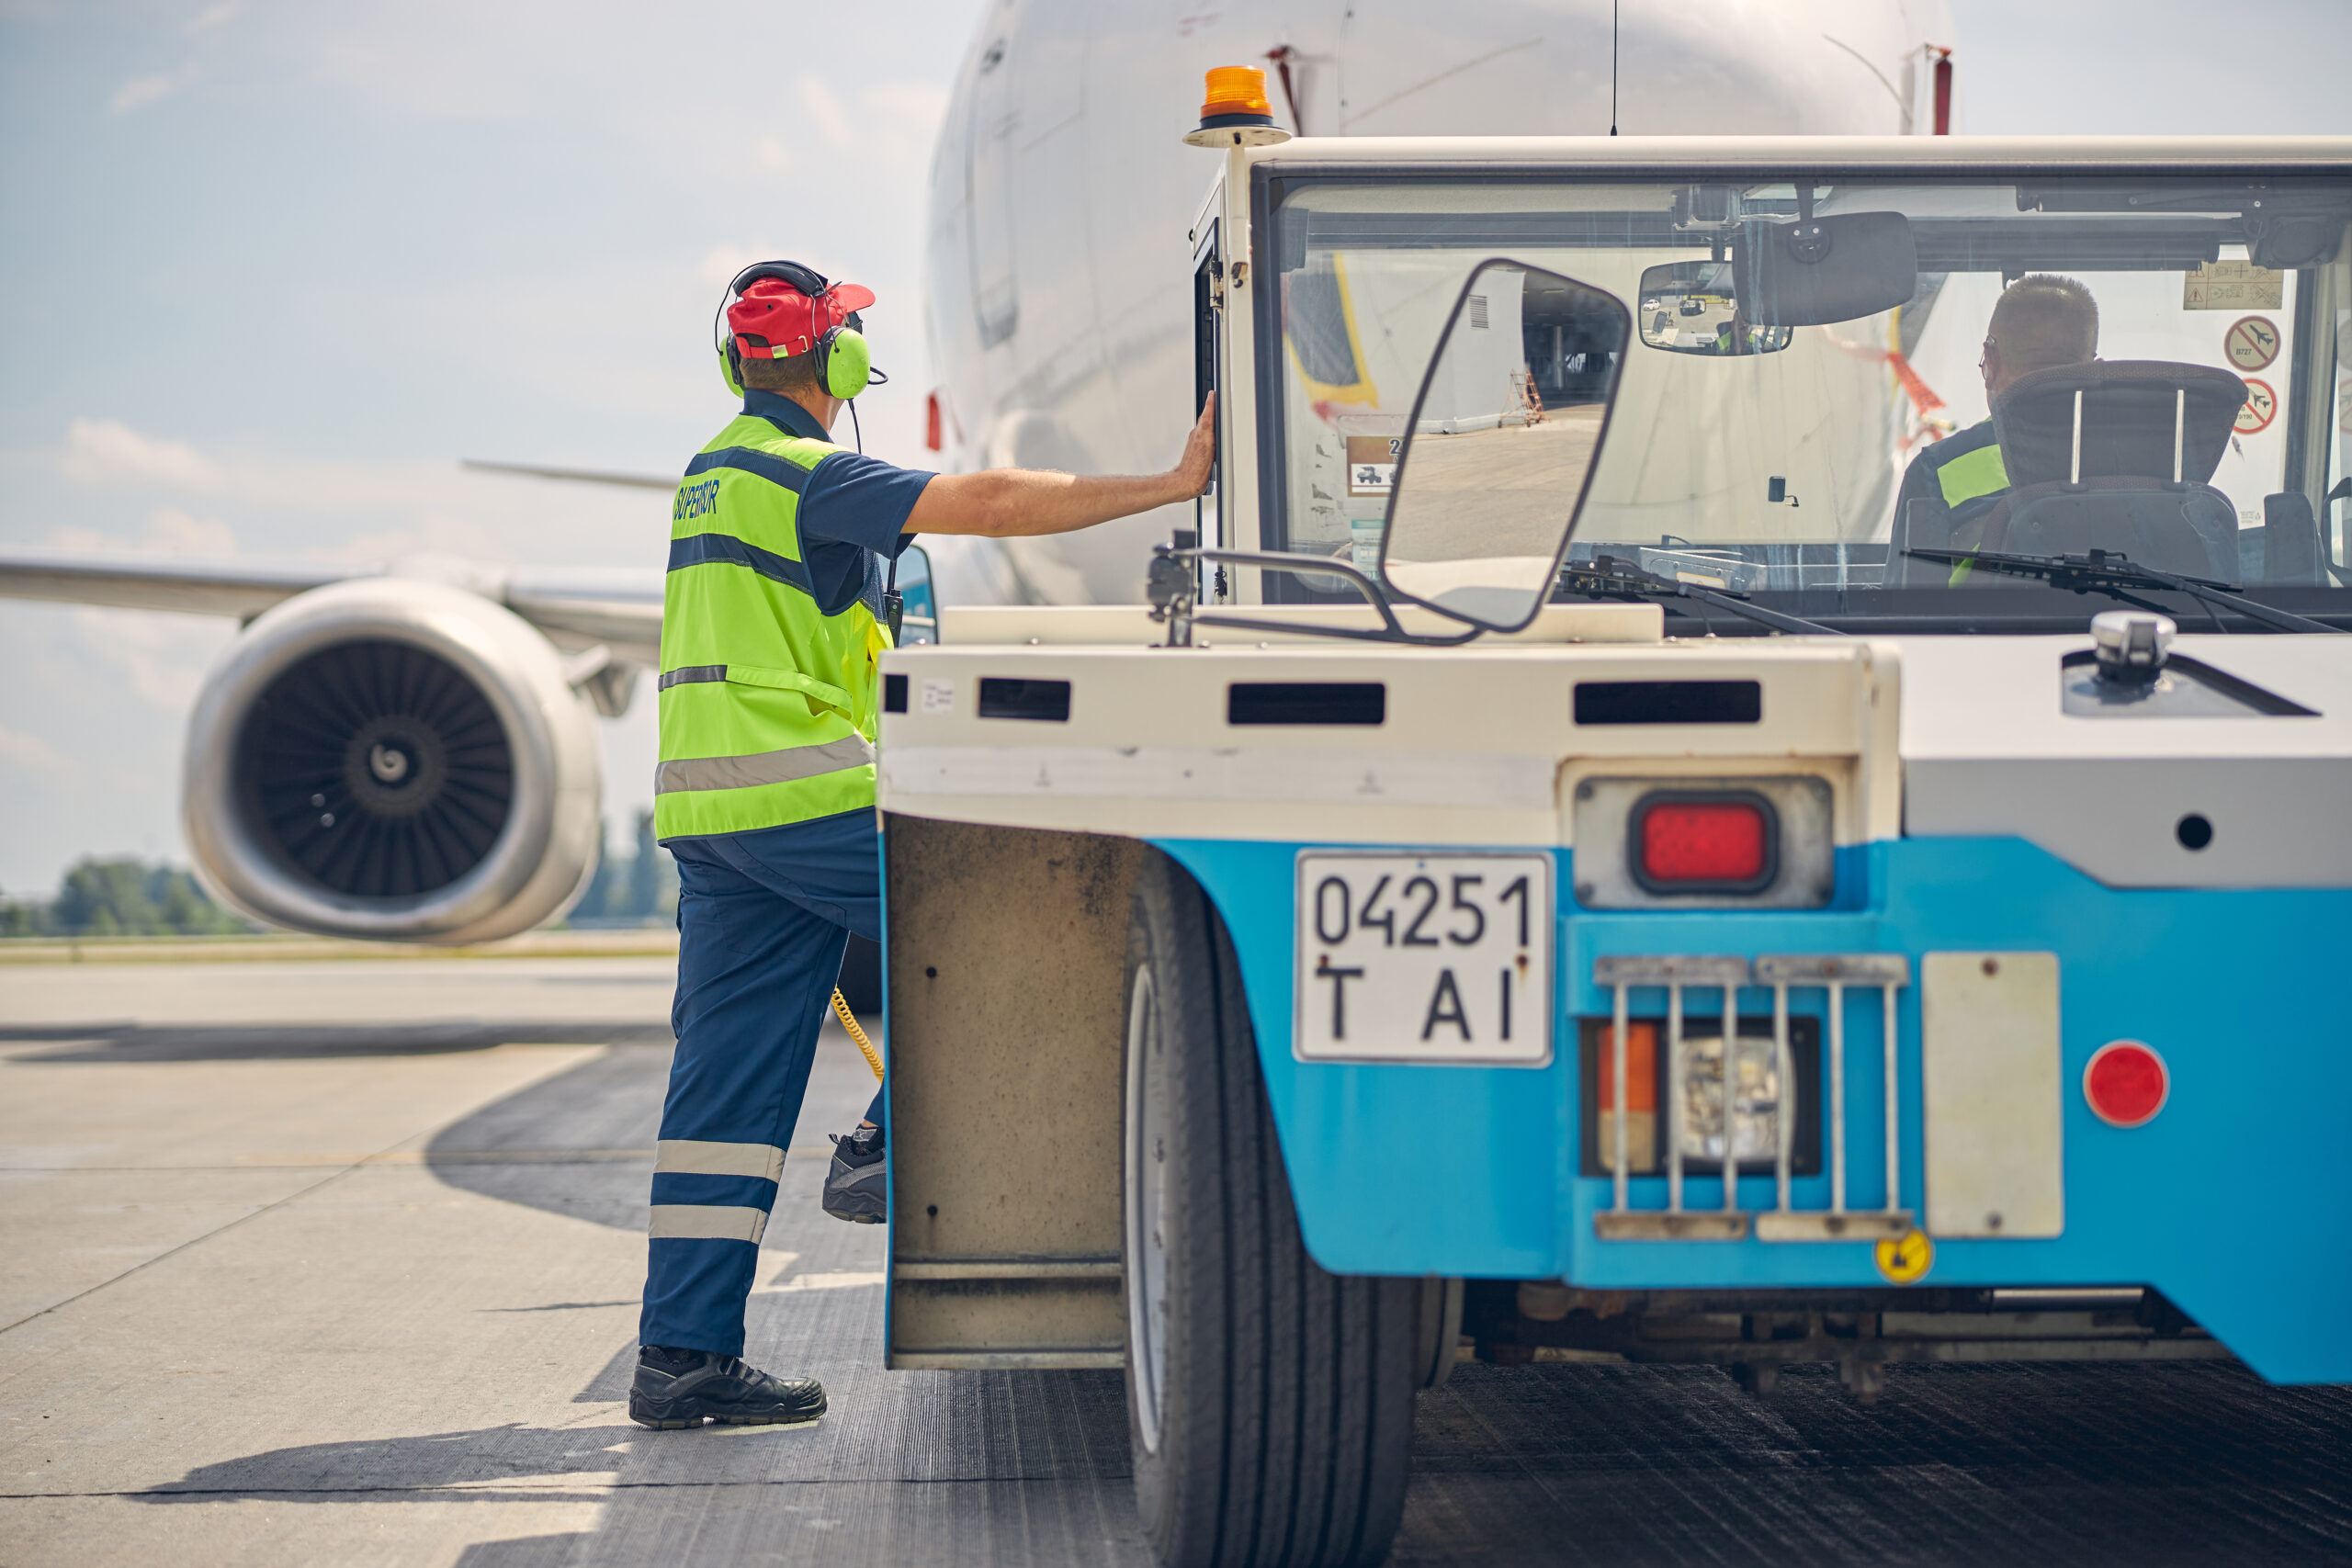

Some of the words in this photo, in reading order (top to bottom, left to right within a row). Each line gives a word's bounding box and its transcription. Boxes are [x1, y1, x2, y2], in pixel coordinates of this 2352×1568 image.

[1389, 439, 1406, 455] 2
[1315, 874, 1530, 947] 04251
[1315, 967, 1364, 1041] T
